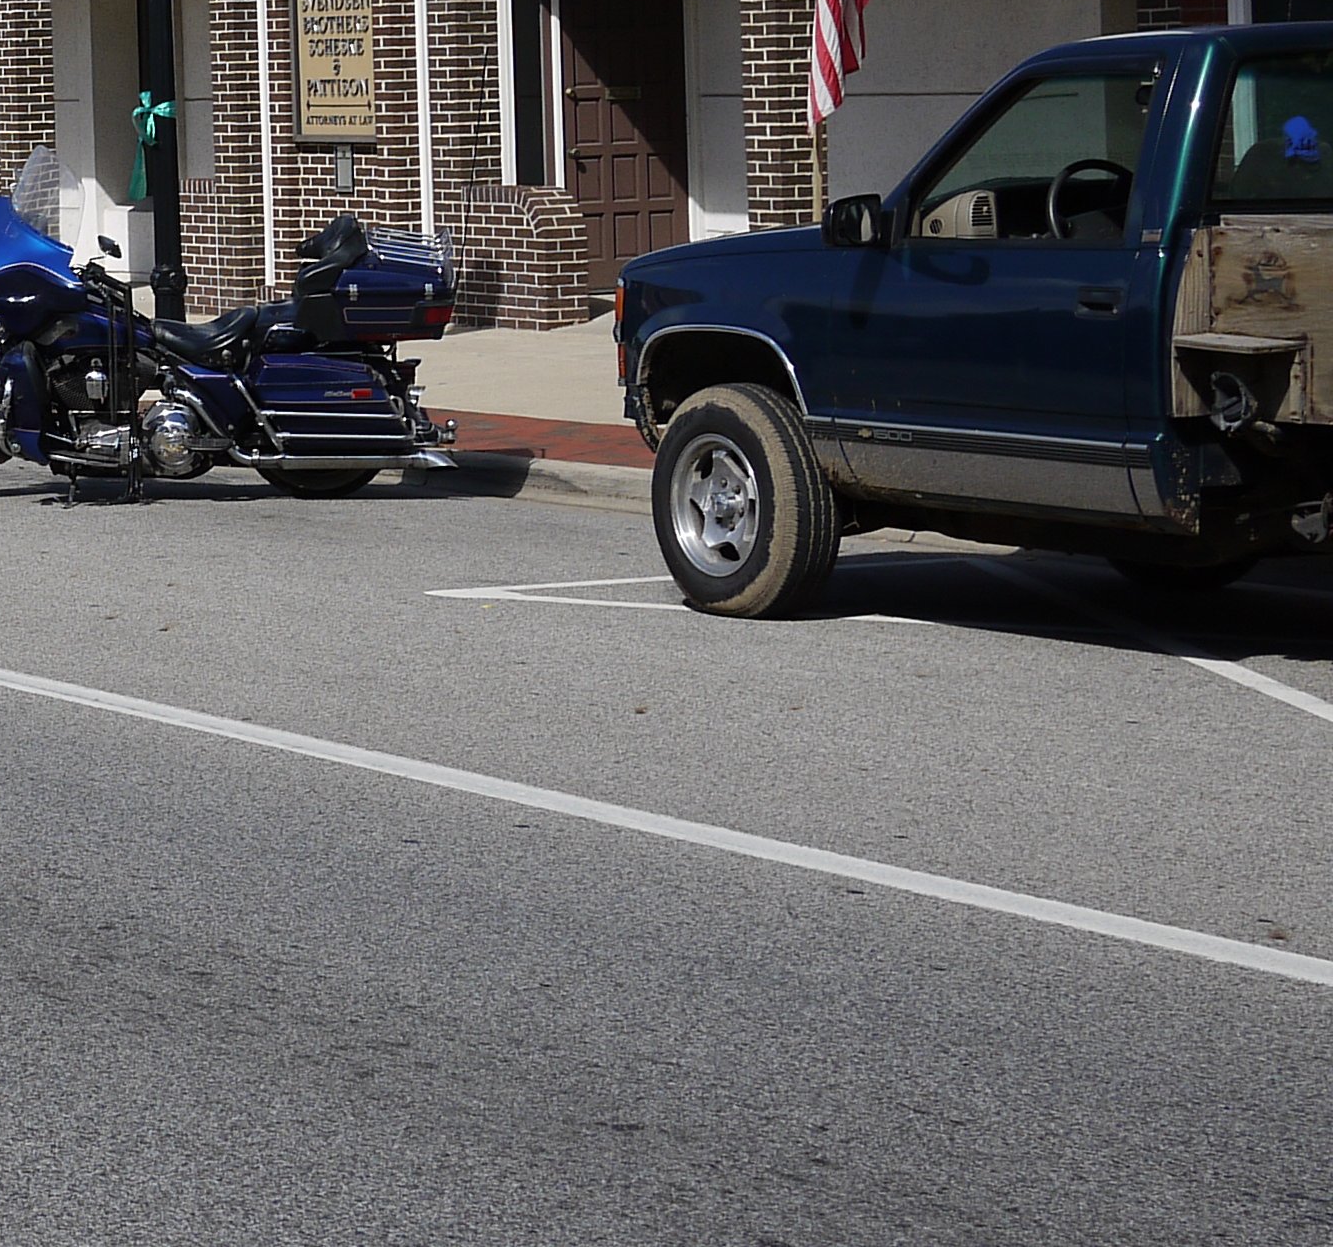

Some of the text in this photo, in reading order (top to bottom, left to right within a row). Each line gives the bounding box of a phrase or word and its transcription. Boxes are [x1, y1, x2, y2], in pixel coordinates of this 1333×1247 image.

[303, 15, 369, 35] BROTHERS
[307, 78, 369, 98] PATTISON
[306, 115, 374, 126] ATTORNEYS AT LAW
